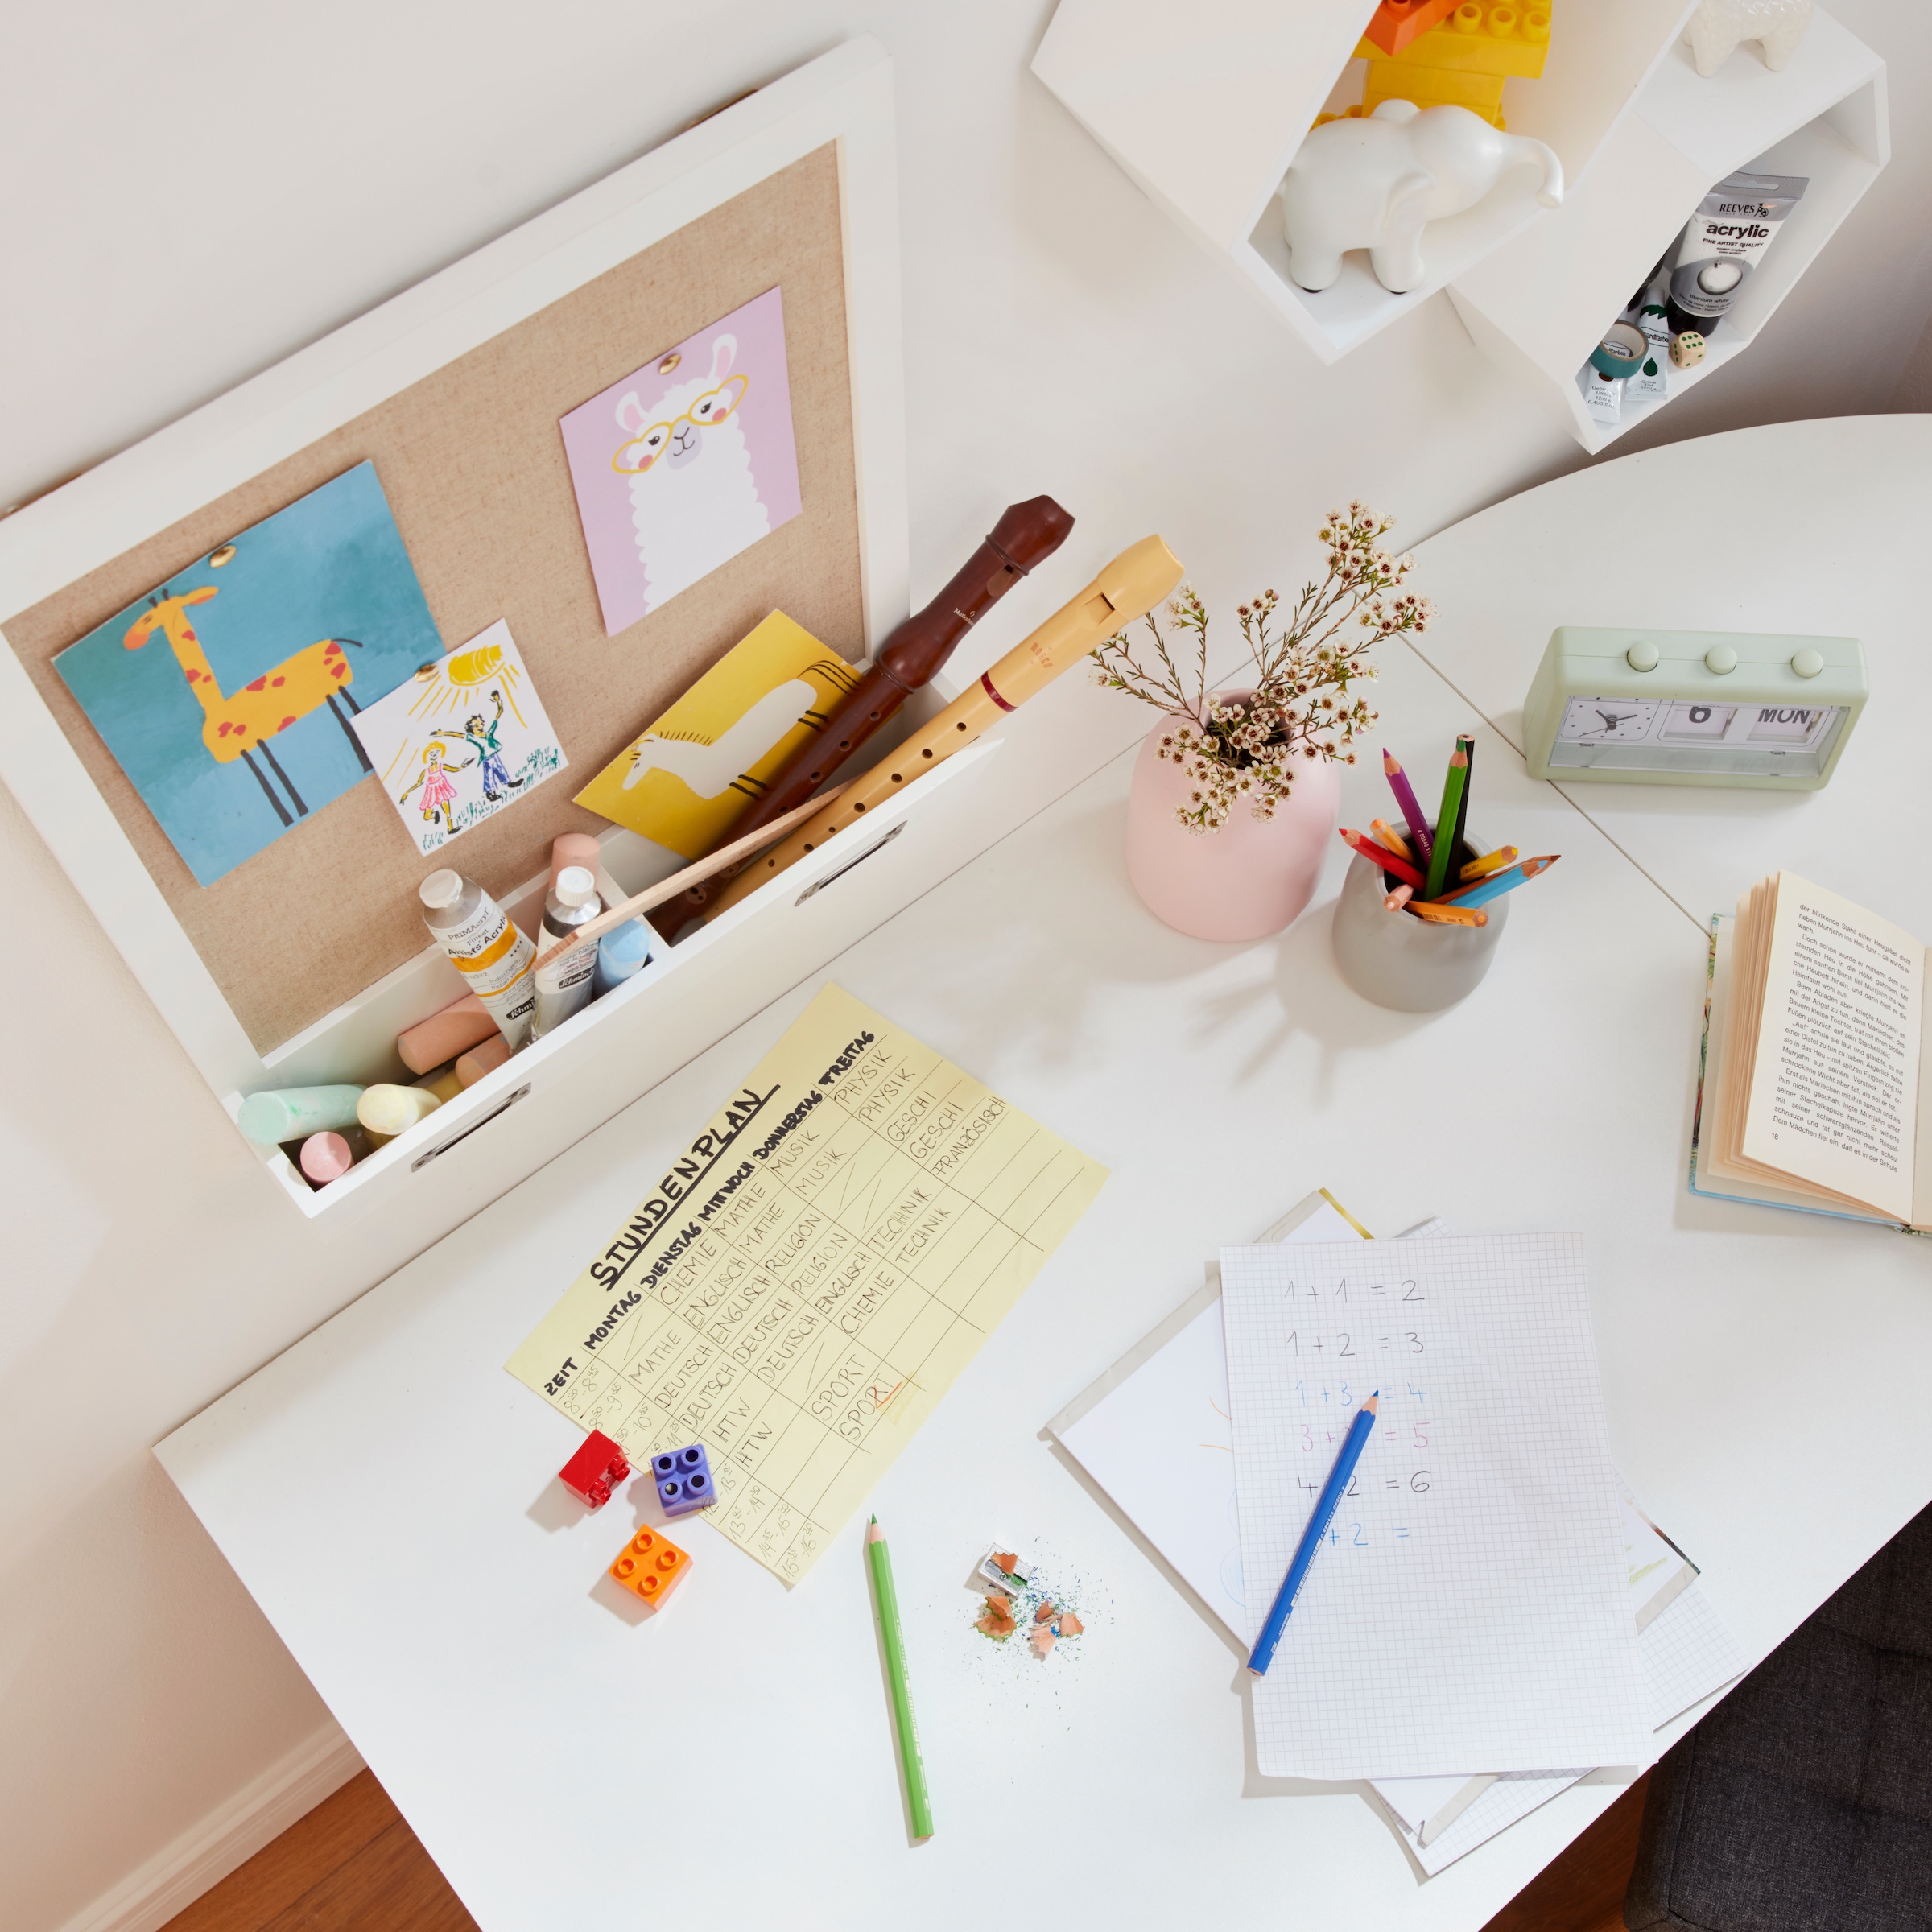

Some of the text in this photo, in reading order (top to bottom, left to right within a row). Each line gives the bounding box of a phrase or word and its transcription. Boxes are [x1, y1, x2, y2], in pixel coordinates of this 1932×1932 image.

[1706, 224, 1769, 239] acrylic
[1719, 203, 1755, 213] REEVES
[1690, 294, 1713, 303] titanium
[1757, 708, 1811, 724] MON
[467, 928, 489, 947] Finest
[1798, 923, 1817, 935] wach.
[1798, 914, 1817, 925] neben
[1818, 921, 1843, 938] Murrjahn
[1843, 935, 1852, 943] ins
[1853, 939, 1864, 948] Heu
[1866, 944, 1876, 954] fuhr
[1889, 959, 1905, 971] wurde
[1799, 904, 1911, 965] der blinkende Stahl einer Heugabel dicht
[491, 976, 510, 991] Indian
[1792, 968, 1847, 998] Heimfahrt wohl aus.
[1794, 951, 1812, 962] einem
[1814, 960, 1835, 972] sanften
[1836, 968, 1852, 981] Bums
[1854, 977, 1863, 986] fiel
[1864, 982, 1887, 999] Murrjahn
[1795, 941, 1821, 956] sternden
[1823, 953, 1835, 964] Heu
[1847, 965, 1856, 973] die
[1858, 970, 1873, 981] Höhe
[1876, 980, 1900, 997] gehoben.
[1802, 933, 1818, 945] Doch
[1819, 943, 1837, 954] schon
[1839, 952, 1856, 964] wurde
[1865, 964, 1886, 979] mitsamt
[1887, 976, 1898, 986] dem
[1793, 960, 1804, 968] che
[1806, 965, 1829, 980] Heubett
[1831, 976, 1849, 990] hinein,
[1852, 987, 1863, 996] und
[1864, 993, 1878, 1004] darin
[1880, 1000, 1891, 1010] hielt
[1772, 1132, 1779, 1141] 18
[590, 1088, 762, 1287] STUNDENPLAN
[660, 1237, 716, 1306] CHEMIE
[714, 1182, 766, 1237] MATHE
[770, 1129, 820, 1177] MUSIK
[834, 1049, 893, 1104] PHYSIK
[543, 1030, 875, 1396] ZEIT MONTAG DIENSTAG MITTWOCH DONNERSTAG FREITAG
[628, 1329, 682, 1385] MATHE
[682, 1257, 747, 1330] ENGLISCH
[738, 1202, 785, 1254] MATHE
[795, 1147, 847, 1195] MUSIK
[858, 1068, 916, 1122] PHYSIK
[654, 1344, 715, 1409] DEUTSCH
[706, 1274, 773, 1344] ENGLISCH
[764, 1213, 823, 1277] RELIGION
[886, 1090, 937, 1142] GESCHI
[678, 1362, 737, 1432] DEUTSCH
[733, 1298, 794, 1365] DEUTSCH
[790, 1232, 848, 1296] RELIGION
[910, 1100, 964, 1159] GESCHI
[712, 1397, 750, 1443] HTW
[756, 1314, 819, 1384] DEUTSCH
[815, 1250, 873, 1315] ENGLISCH
[865, 1187, 932, 1249] TECHNIK
[929, 1096, 1008, 1175] FRANZÖSISCH
[1284, 1280, 1294, 1305] 1
[1335, 1278, 1347, 1303] 1
[1402, 1280, 1425, 1302] 2
[734, 1207, 953, 1468] HTW CHEMIE TECHNIK
[1286, 1331, 1298, 1356] 1
[1337, 1333, 1356, 1356] 2
[1404, 1332, 1424, 1353] 3
[811, 1353, 865, 1421] SPORT
[839, 1372, 894, 1441] SPORT
[1294, 1380, 1306, 1406] 1
[1340, 1381, 1352, 1406] 3
[1407, 1382, 1428, 1404] 4
[1300, 1424, 1313, 1452] 3
[1413, 1422, 1430, 1448] 5
[1298, 1476, 1318, 1498] 4
[1346, 1475, 1360, 1496] 2
[1410, 1470, 1430, 1493] 6
[1348, 1523, 1368, 1546] 2
